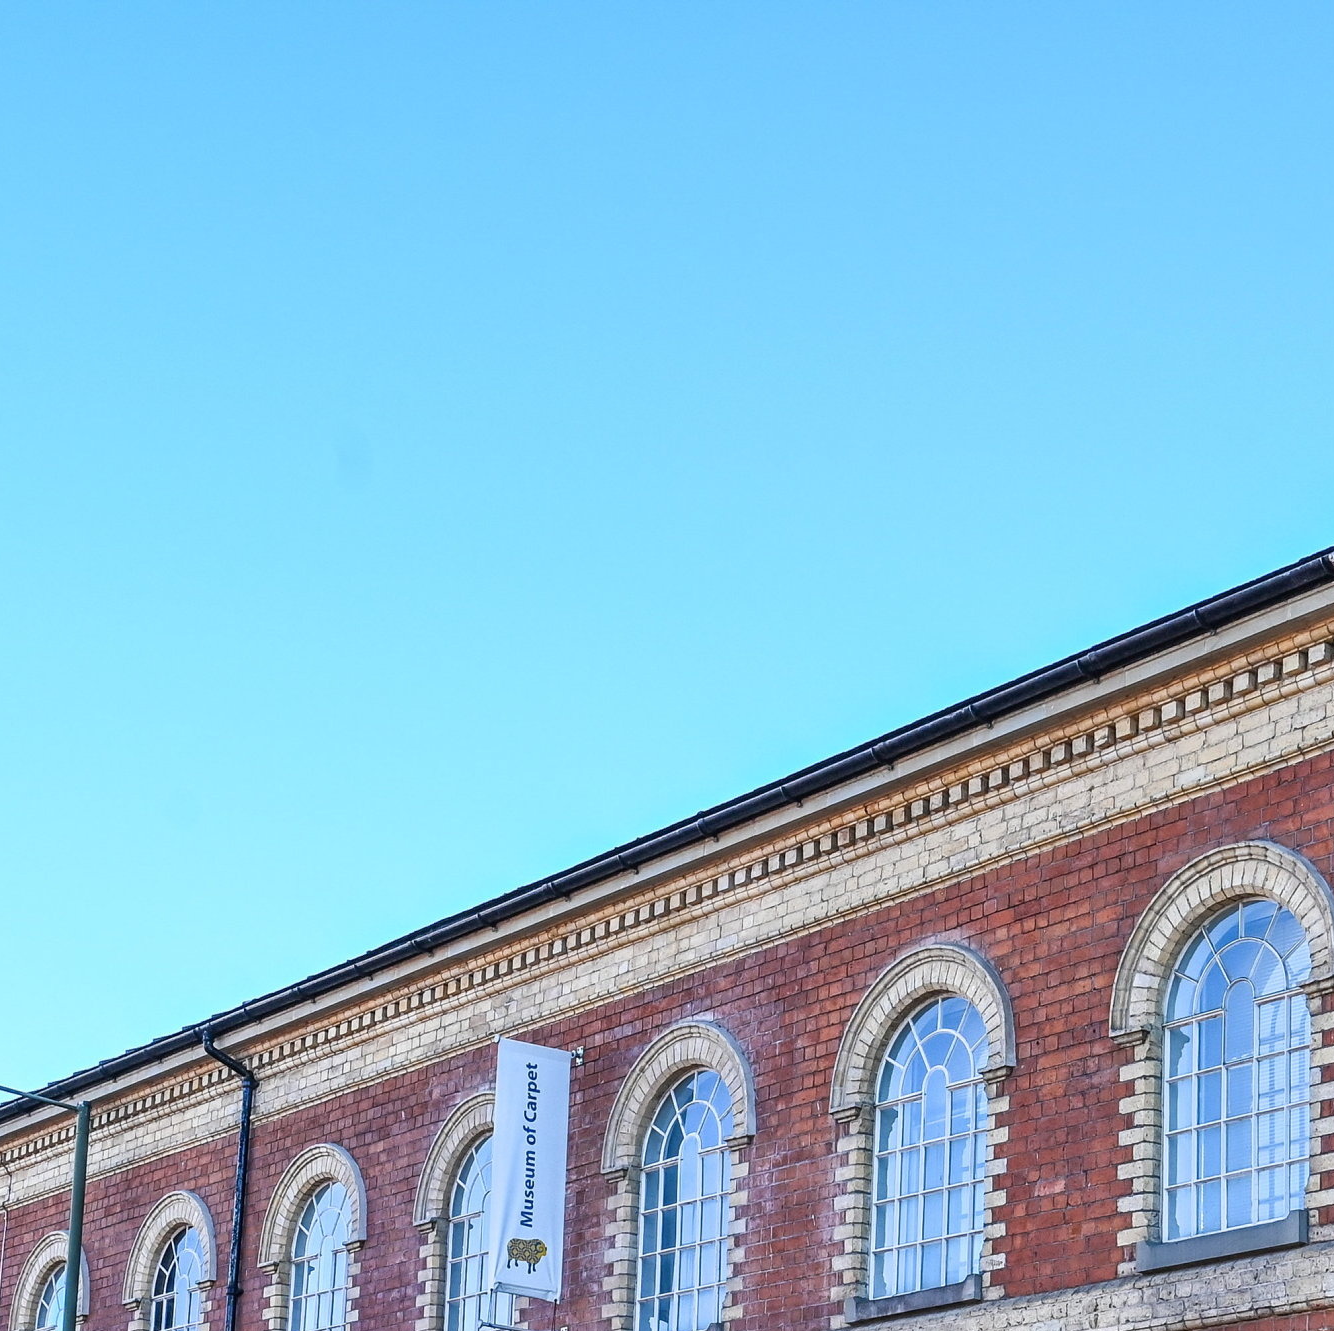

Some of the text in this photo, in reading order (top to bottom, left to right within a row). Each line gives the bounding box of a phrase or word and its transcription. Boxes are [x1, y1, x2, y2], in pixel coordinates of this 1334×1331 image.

[520, 1062, 540, 1228] Museum of Carpet
